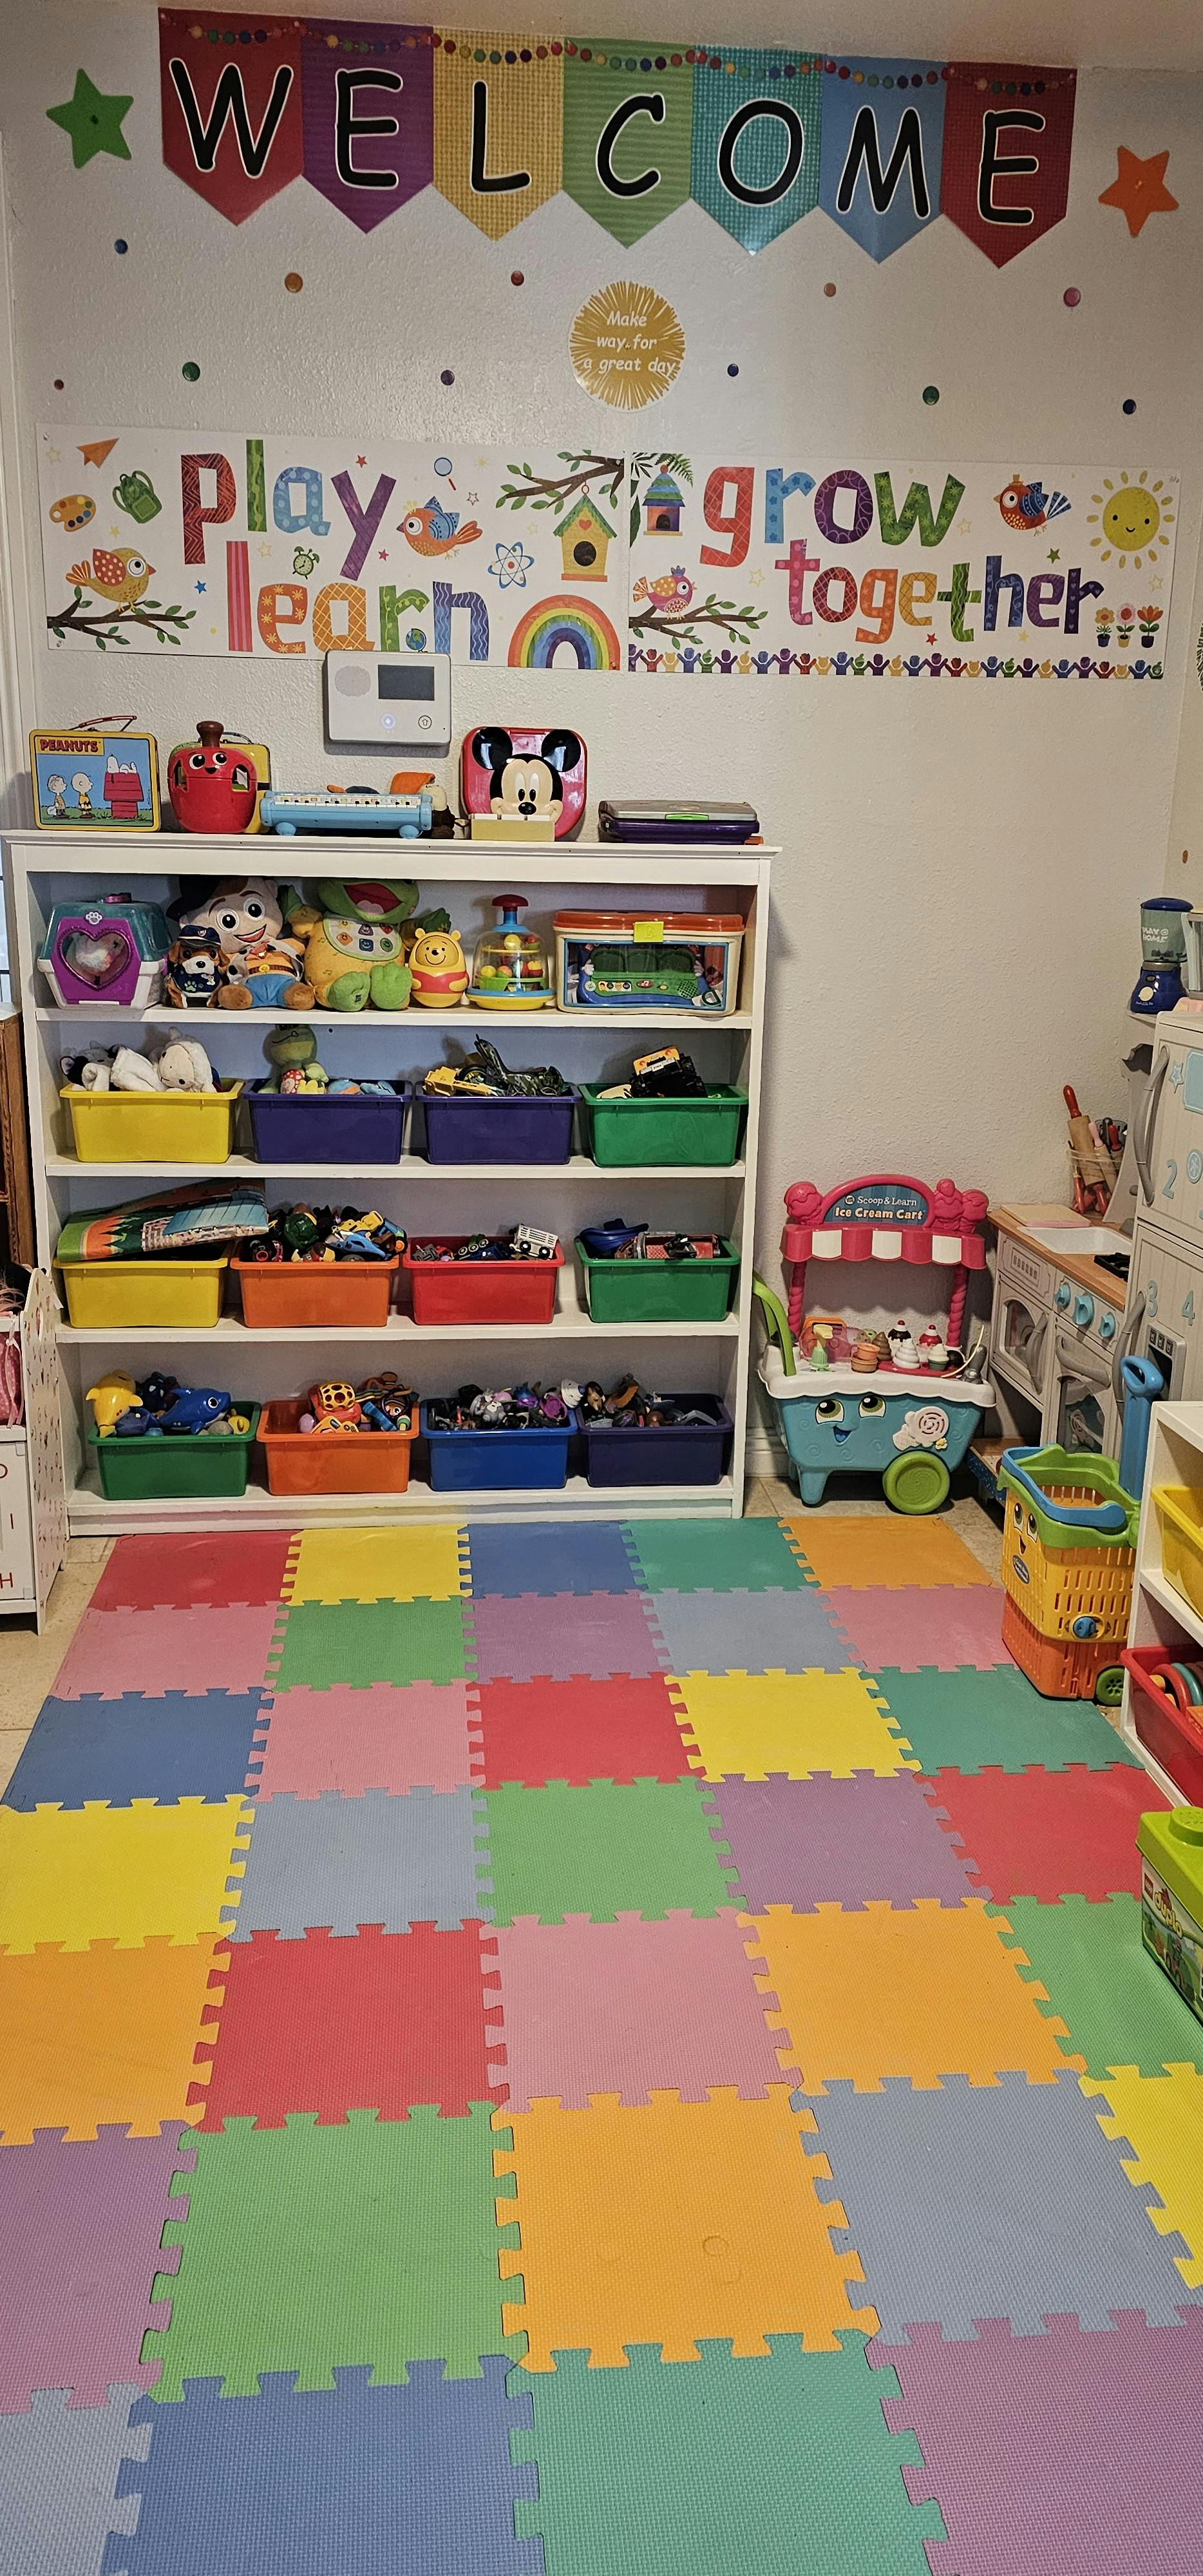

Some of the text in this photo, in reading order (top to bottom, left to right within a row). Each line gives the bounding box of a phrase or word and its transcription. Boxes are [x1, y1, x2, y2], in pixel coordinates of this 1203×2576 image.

[169, 58, 1045, 225] WELCOME
[607, 310, 647, 327] Make
[596, 333, 658, 353] way for
[583, 357, 676, 377] a great day
[181, 439, 397, 581] play
[699, 466, 966, 567] grow
[226, 540, 489, 661] learn
[775, 538, 1104, 645] together
[40, 739, 99, 753] PEANUTS
[1162, 1159, 1178, 1199] 2
[835, 1208, 924, 1220] Ice Cream Cart
[857, 1196, 884, 1206] Scoop
[1147, 1280, 1159, 1318] 3
[1182, 1290, 1195, 1326] 4
[1154, 1890, 1184, 1939] duplo
